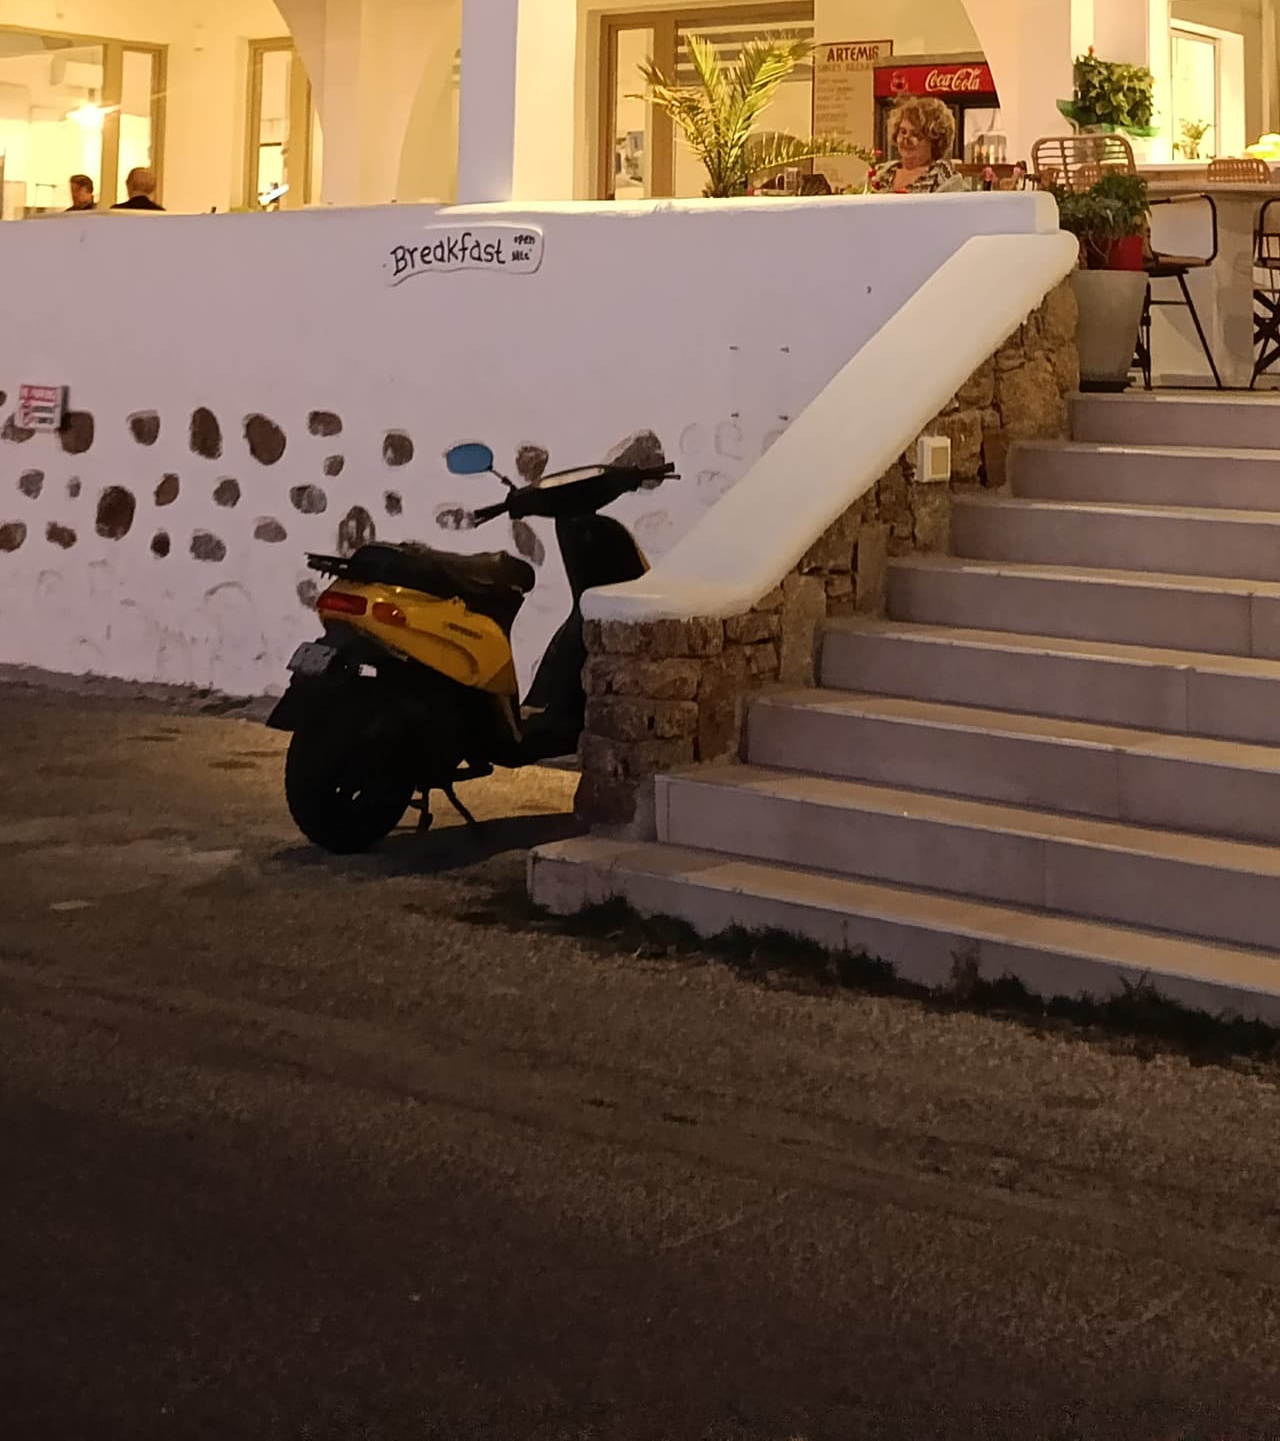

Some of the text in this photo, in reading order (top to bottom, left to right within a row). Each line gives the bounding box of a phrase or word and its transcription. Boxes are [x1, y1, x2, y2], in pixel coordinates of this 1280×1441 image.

[827, 45, 880, 63] ARTEMIS
[924, 68, 983, 93] Coca-Cola
[390, 232, 506, 276] Breakfast
